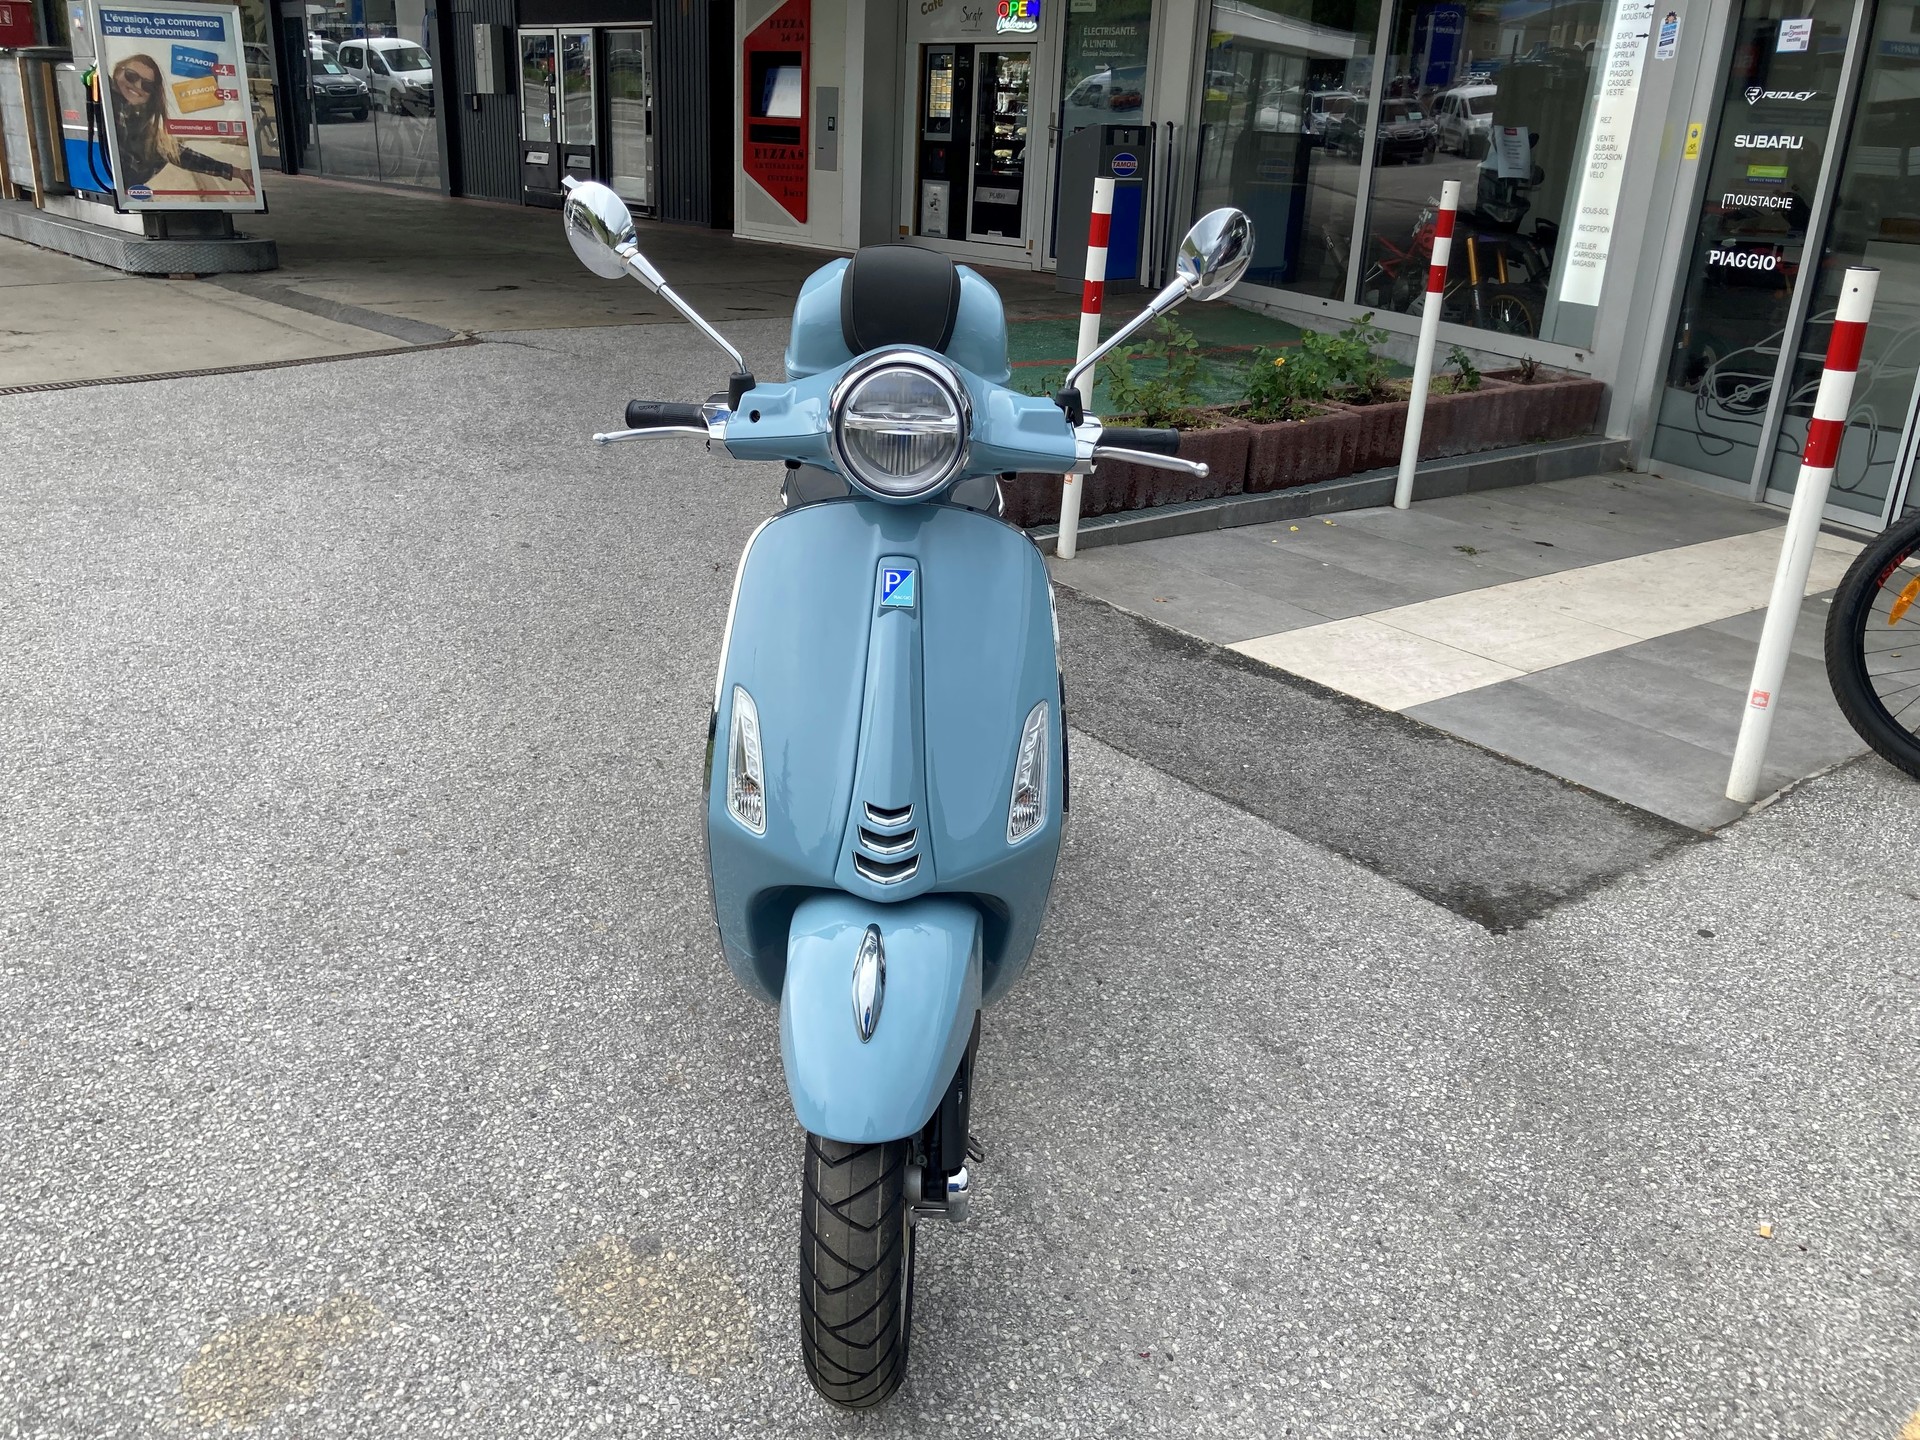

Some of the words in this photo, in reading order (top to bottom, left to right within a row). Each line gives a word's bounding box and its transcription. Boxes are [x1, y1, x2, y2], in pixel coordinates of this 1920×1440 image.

[997, 0, 1040, 17] OPEN
[104, 14, 152, 25] L'évasion,
[154, 17, 165, 26] ça
[167, 19, 219, 28] commence
[770, 19, 804, 28] PIZZA
[996, 16, 1037, 34] Welcome
[125, 25, 142, 34] des
[1083, 25, 1138, 35] ÉLECTRISANTE.
[1762, 91, 1817, 101] RIDLEY
[1734, 135, 1803, 149] SUBARU
[754, 148, 804, 159] PIZZAS
[1722, 194, 1793, 209] MOUSTACHE
[1582, 207, 1609, 215] SOUS-SOL
[1579, 224, 1610, 233] RECEPTION
[1575, 242, 1597, 250] ATELIER
[1571, 259, 1596, 268] MAGASIN
[1709, 250, 1777, 270] PIAGGIO
[885, 572, 901, 592] P
